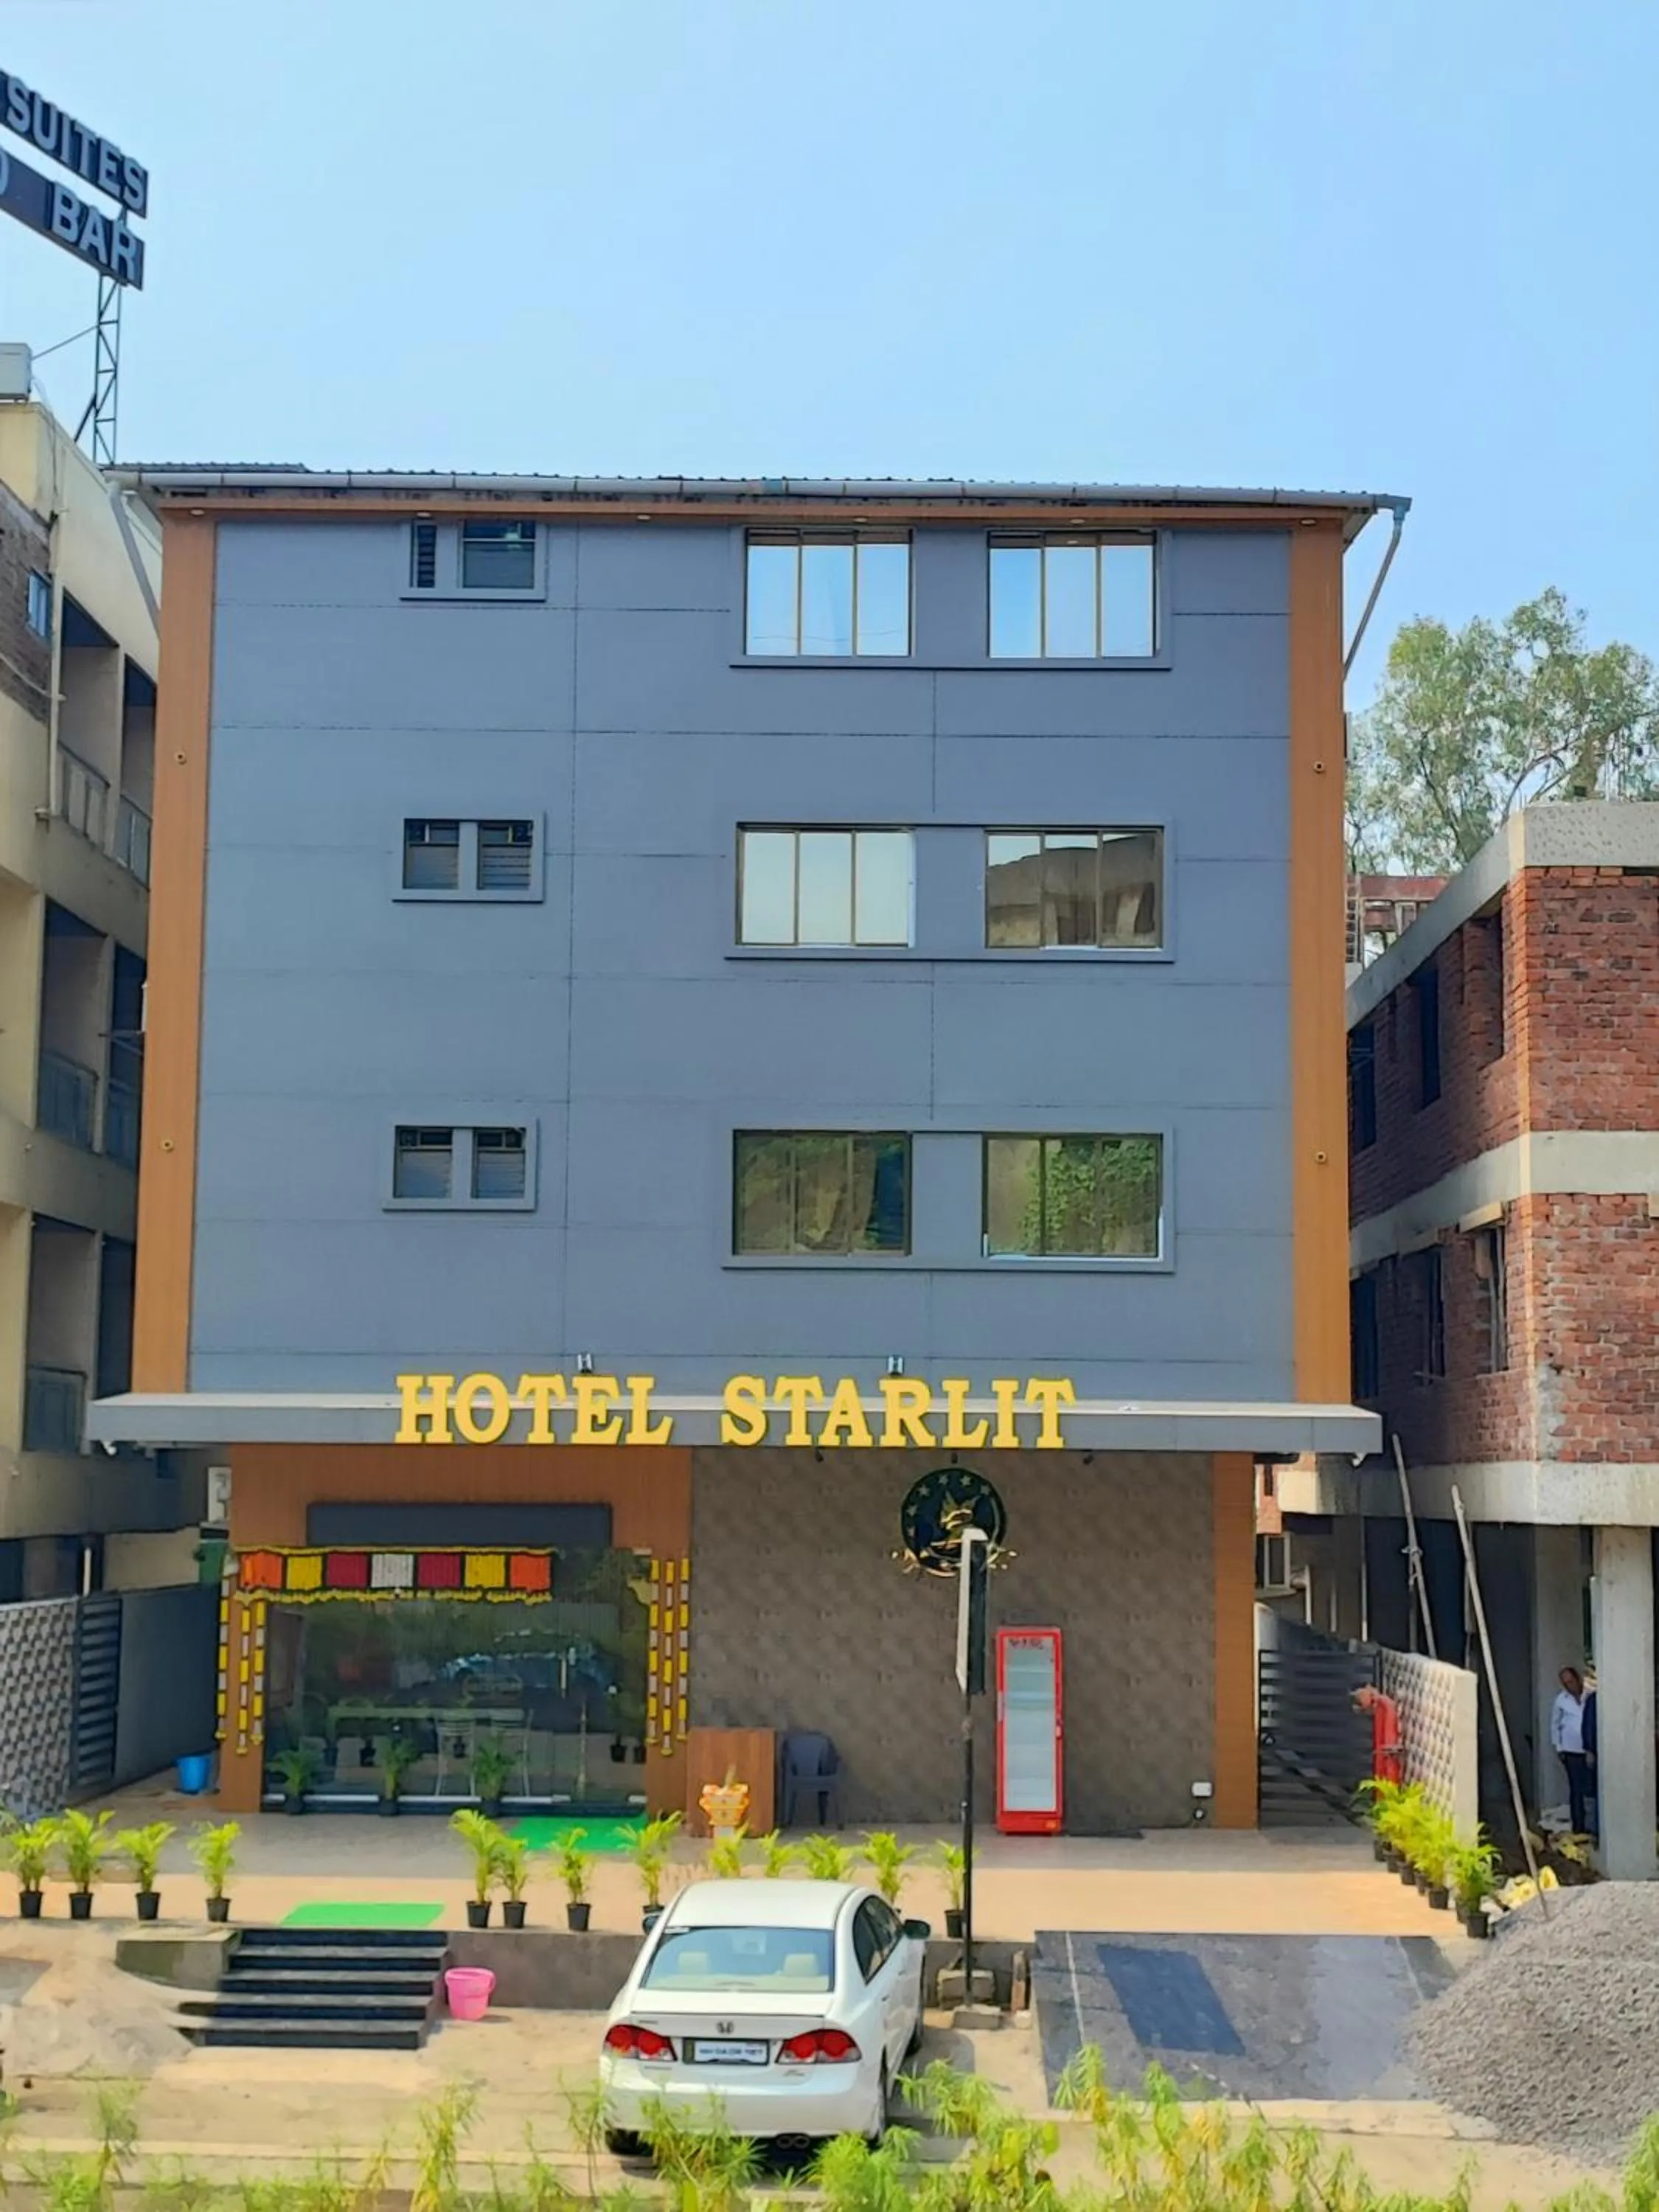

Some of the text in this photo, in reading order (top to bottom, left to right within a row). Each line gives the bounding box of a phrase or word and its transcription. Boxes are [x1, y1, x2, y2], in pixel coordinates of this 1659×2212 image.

[7, 76, 146, 209] SUITES
[52, 181, 136, 281] BAR
[395, 1373, 1075, 1448] HOTEL STARLIT
